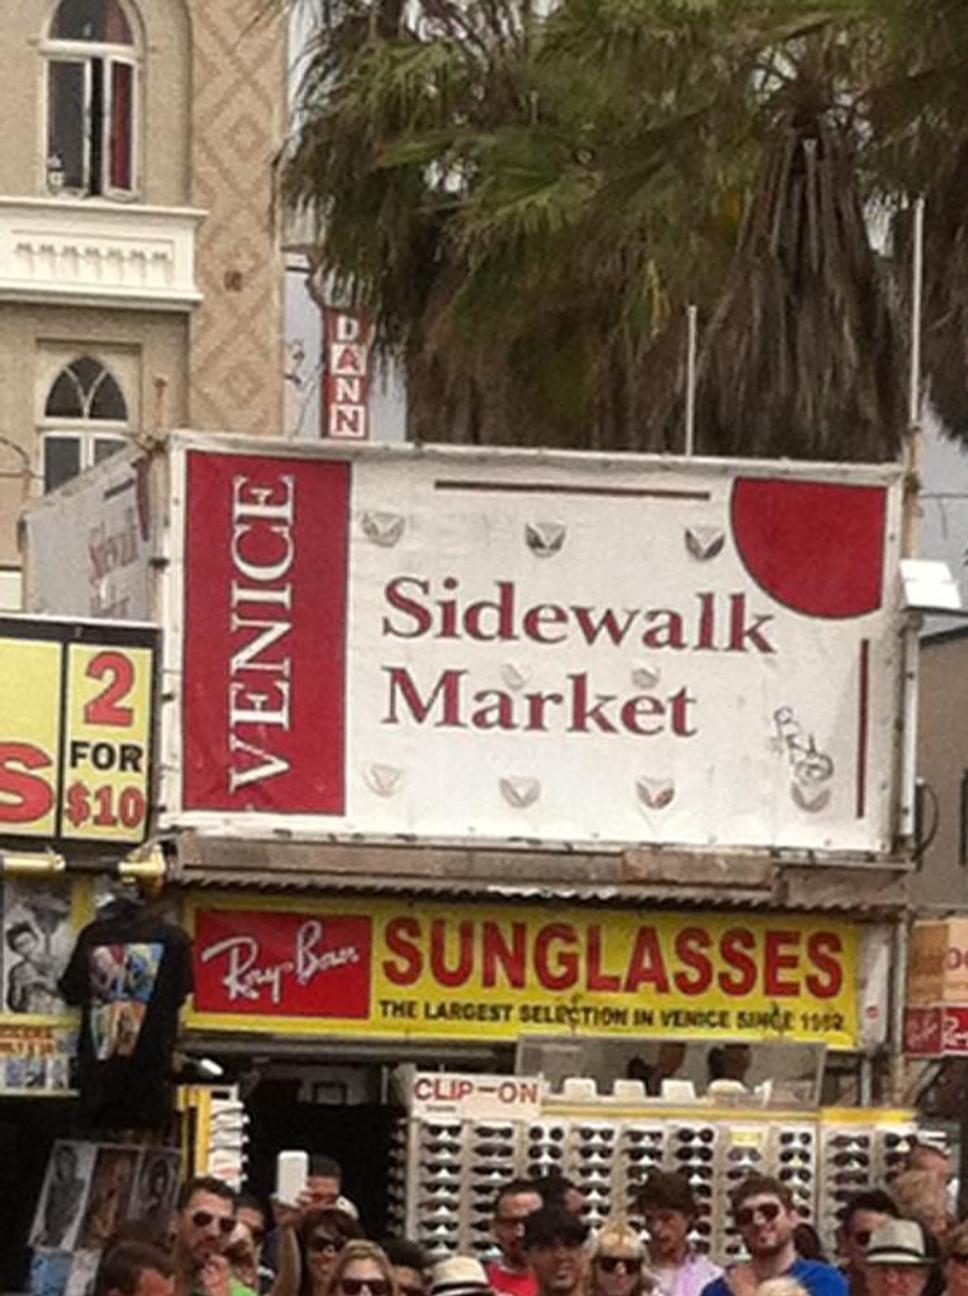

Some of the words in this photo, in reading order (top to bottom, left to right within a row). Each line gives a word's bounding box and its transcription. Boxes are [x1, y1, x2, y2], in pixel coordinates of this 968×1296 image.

[228, 474, 295, 792] VENICE
[382, 576, 777, 654] Sidewalk
[83, 650, 136, 728] 2
[381, 665, 698, 738] Market
[69, 740, 145, 772] FOR
[65, 781, 145, 829] $10
[201, 920, 360, 1004] Ray-Ban
[381, 917, 844, 999] SUNGLASSES
[380, 1000, 417, 1018] THE
[424, 1001, 513, 1022] LARGEST
[519, 1004, 628, 1026] SELECTION
[633, 1009, 653, 1026] IN
[660, 1009, 730, 1029] VENICE
[736, 1011, 794, 1031] SINCE
[414, 1077, 538, 1104] CLIP-ON
